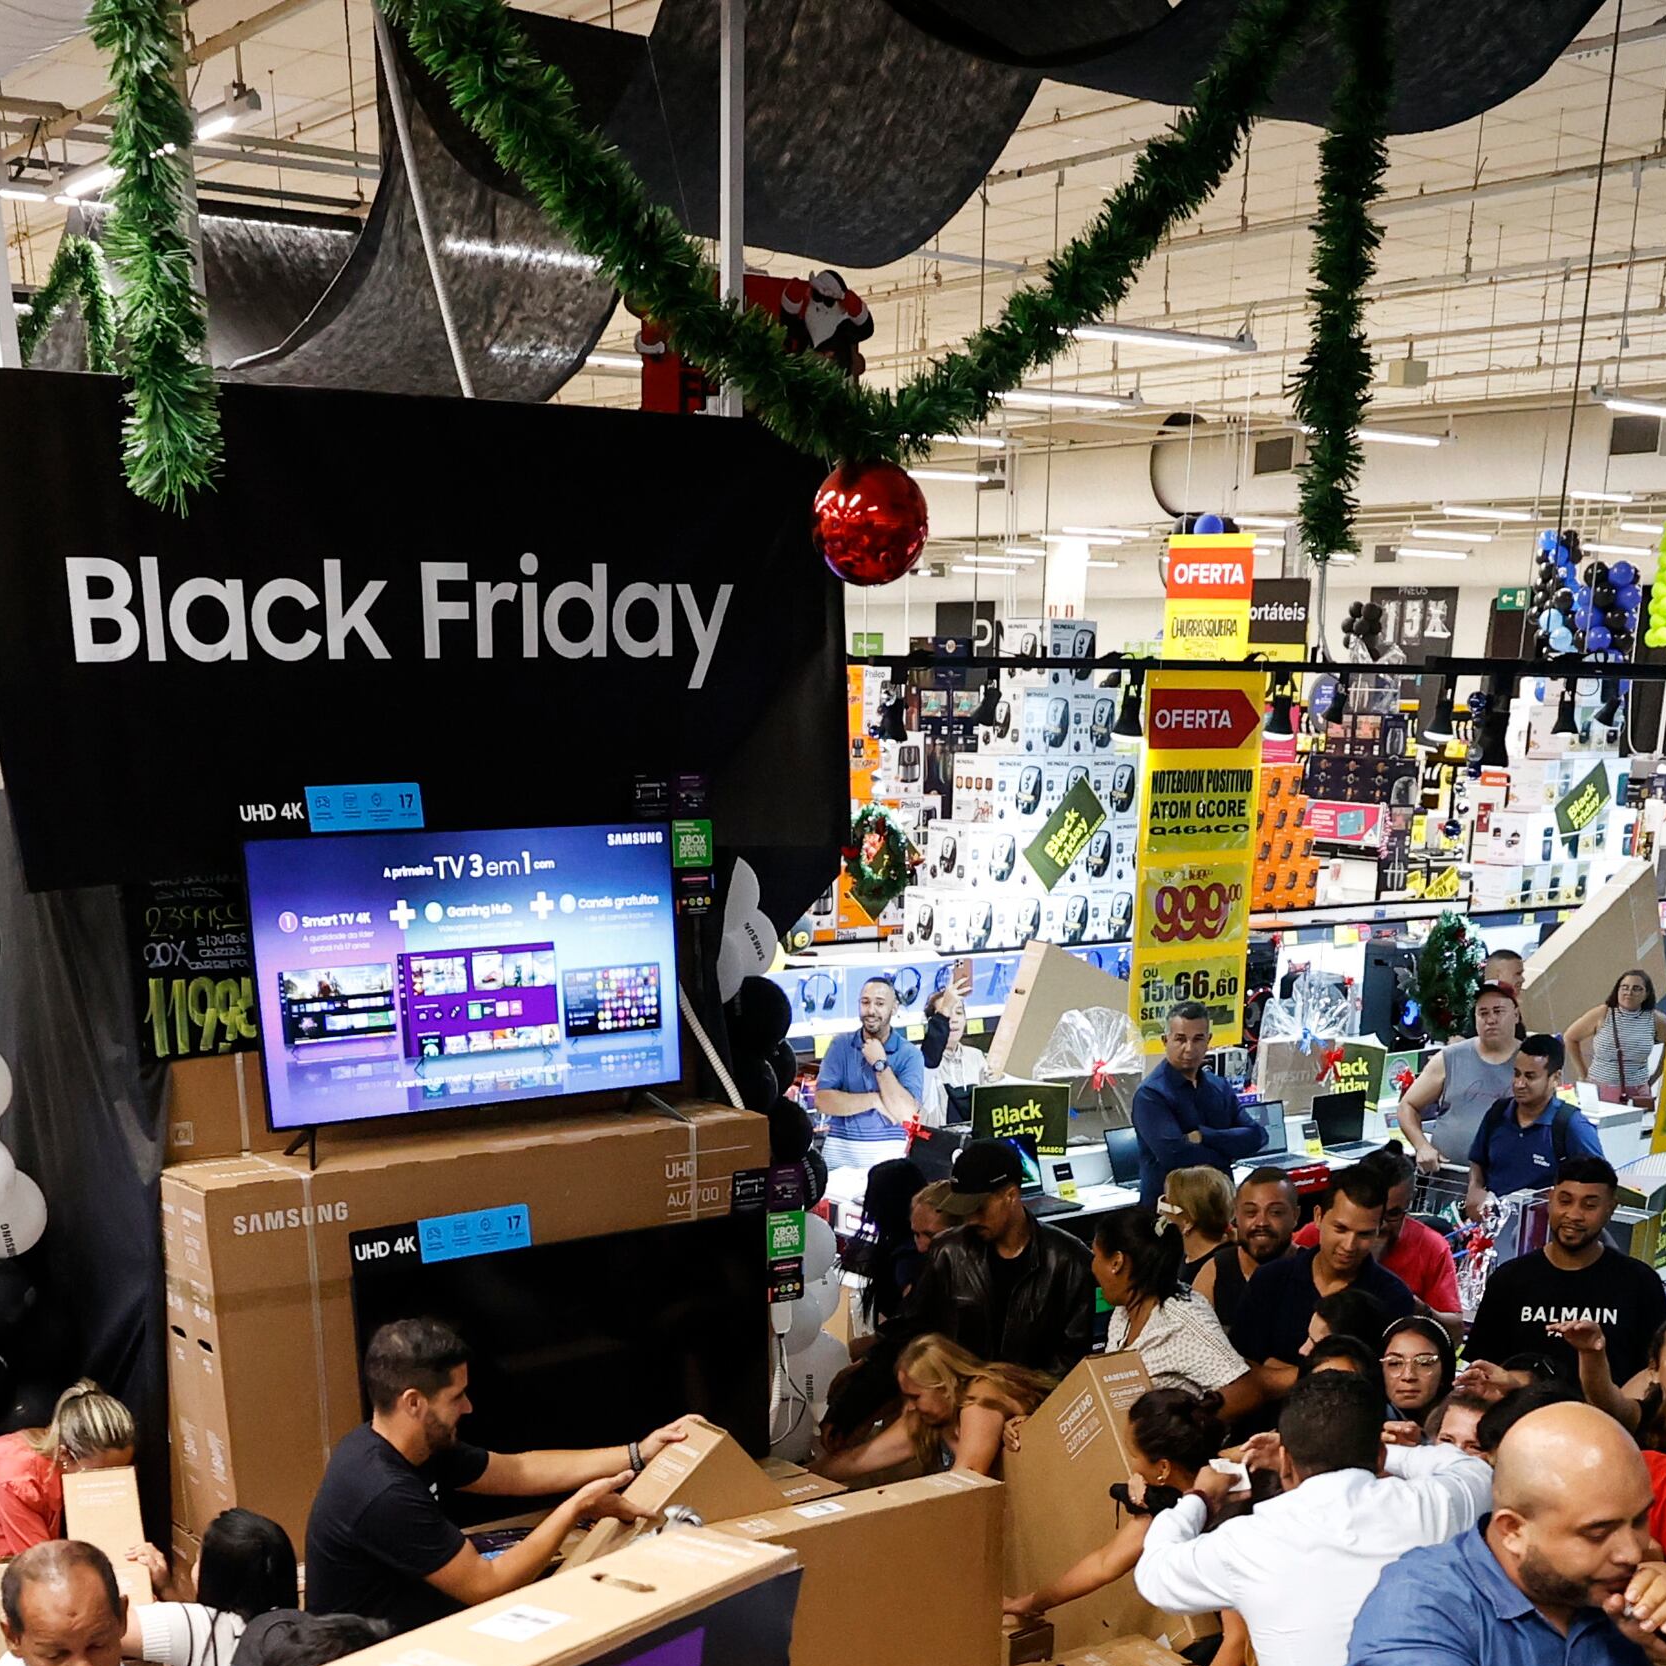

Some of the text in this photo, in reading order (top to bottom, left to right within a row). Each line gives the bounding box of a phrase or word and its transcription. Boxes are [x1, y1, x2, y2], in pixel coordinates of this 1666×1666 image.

[1173, 561, 1245, 585] OFERTA
[1398, 585, 1429, 596] PNEUS
[64, 552, 734, 690] Black Friday
[1249, 601, 1307, 622] ortáteis
[1154, 707, 1233, 730] OFERTA
[1151, 768, 1253, 795] NOTEBOOK POSITIVO
[239, 803, 275, 824] UHD
[277, 802, 305, 821] 4K
[1150, 799, 1247, 820] ATOM QCORE
[606, 831, 664, 848] SAMSUNG
[1044, 806, 1080, 859] Black
[1054, 816, 1089, 868] Friday
[392, 850, 556, 880] primeira TV 3 em 1 com
[447, 902, 513, 921] Gaming Hub
[578, 894, 660, 911] Canais gratuitos
[301, 911, 372, 929] Smart TV 4K
[1143, 968, 1158, 979] OU
[991, 1099, 1044, 1127] Black
[664, 1160, 695, 1179] UHD
[232, 1200, 350, 1236] SAMSUNG
[354, 1214, 522, 1262] UHD 4K 17
[1520, 1306, 1618, 1326] BALMAIN
